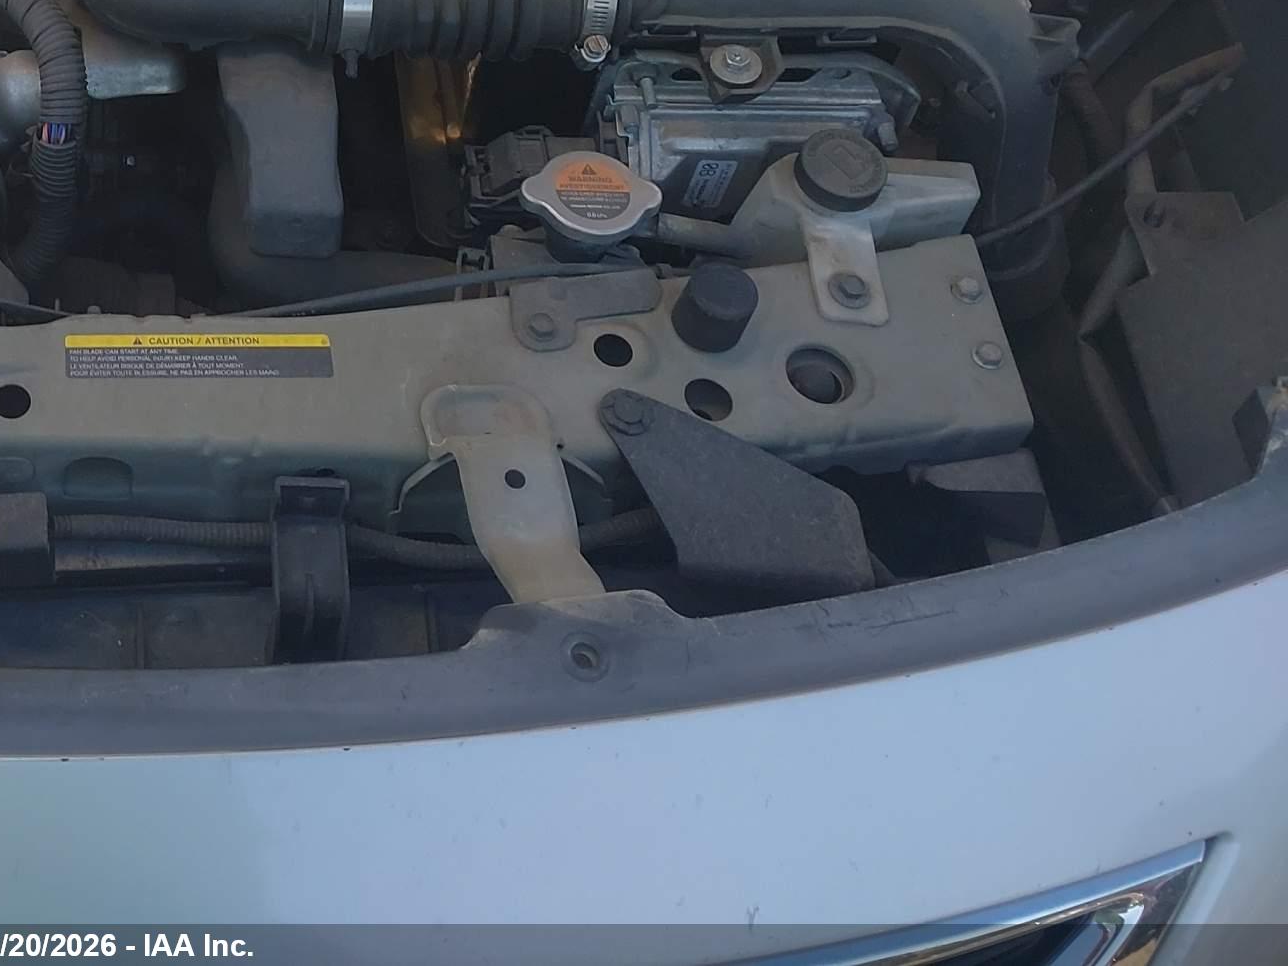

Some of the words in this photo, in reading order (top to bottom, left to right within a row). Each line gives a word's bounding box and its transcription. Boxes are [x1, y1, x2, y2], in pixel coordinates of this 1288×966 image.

[148, 337, 194, 345] CAUTION
[196, 337, 202, 345] /
[205, 337, 260, 345] ATTENTION
